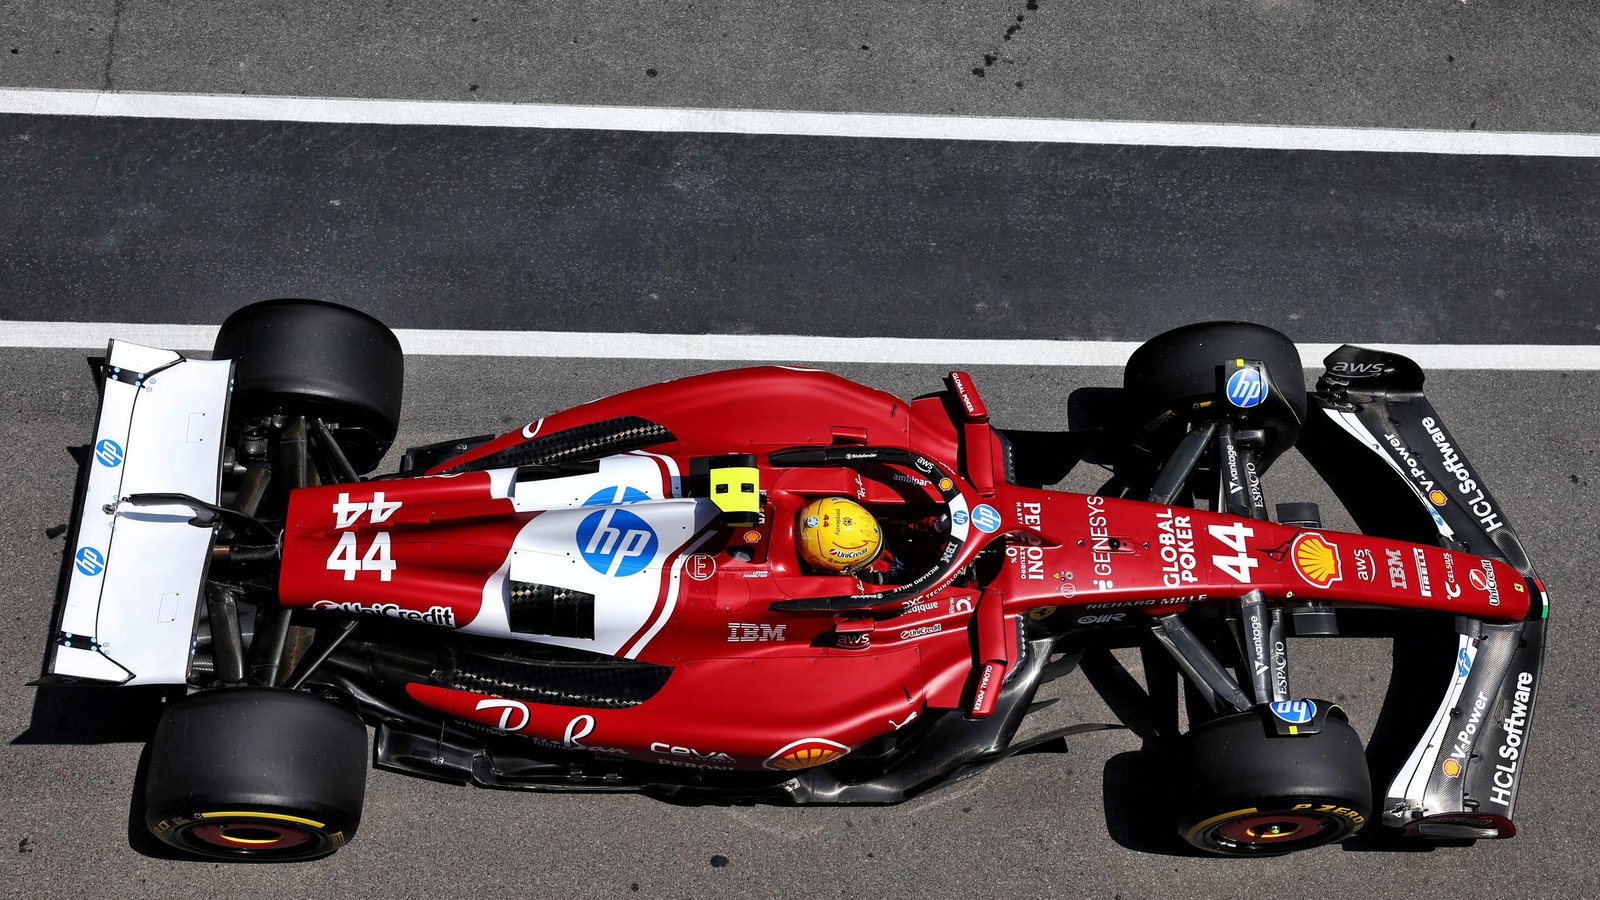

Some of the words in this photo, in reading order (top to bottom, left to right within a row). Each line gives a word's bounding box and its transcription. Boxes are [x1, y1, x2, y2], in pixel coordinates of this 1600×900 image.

[1332, 361, 1384, 374] aws
[952, 372, 965, 394] GLOBAL
[962, 394, 974, 412] POKER
[1228, 369, 1267, 407] hp
[96, 439, 123, 467] hp
[916, 456, 934, 470] aws
[1227, 444, 1238, 482] vantage
[1384, 433, 1435, 492] V-Power
[1246, 462, 1263, 508] ESPACIO
[1422, 416, 1503, 533] HCLSoftware
[953, 510, 968, 525] hp
[971, 504, 1001, 533] hp
[1086, 496, 1112, 576] GENESYS
[76, 547, 105, 576] hp
[326, 531, 397, 582] 44
[575, 508, 659, 577] hp
[940, 541, 958, 564] IBM
[1155, 508, 1181, 589] GLOBAL
[1174, 516, 1199, 583] POKER
[1207, 522, 1259, 584] 44
[913, 565, 940, 585] RICHARD
[1353, 549, 1370, 581] aws
[1385, 548, 1408, 589] IBM
[1413, 547, 1432, 597] PIRELLI
[1480, 559, 1500, 606] UniCredit
[892, 582, 914, 593] MILLE
[1086, 599, 1156, 610] RICHARD
[1160, 594, 1208, 605] MILLE
[727, 622, 787, 642] IBM
[838, 633, 870, 644] aws
[909, 623, 942, 637] UniCredit
[1250, 615, 1262, 661] vantage
[980, 665, 992, 689] GLOBAL
[1276, 641, 1287, 695] ESPACIO
[973, 690, 985, 711] POKER
[1451, 691, 1489, 759] V-Power
[1490, 672, 1533, 806] HCLSoftware
[1291, 803, 1312, 811] P
[1315, 804, 1364, 824] ZERO
